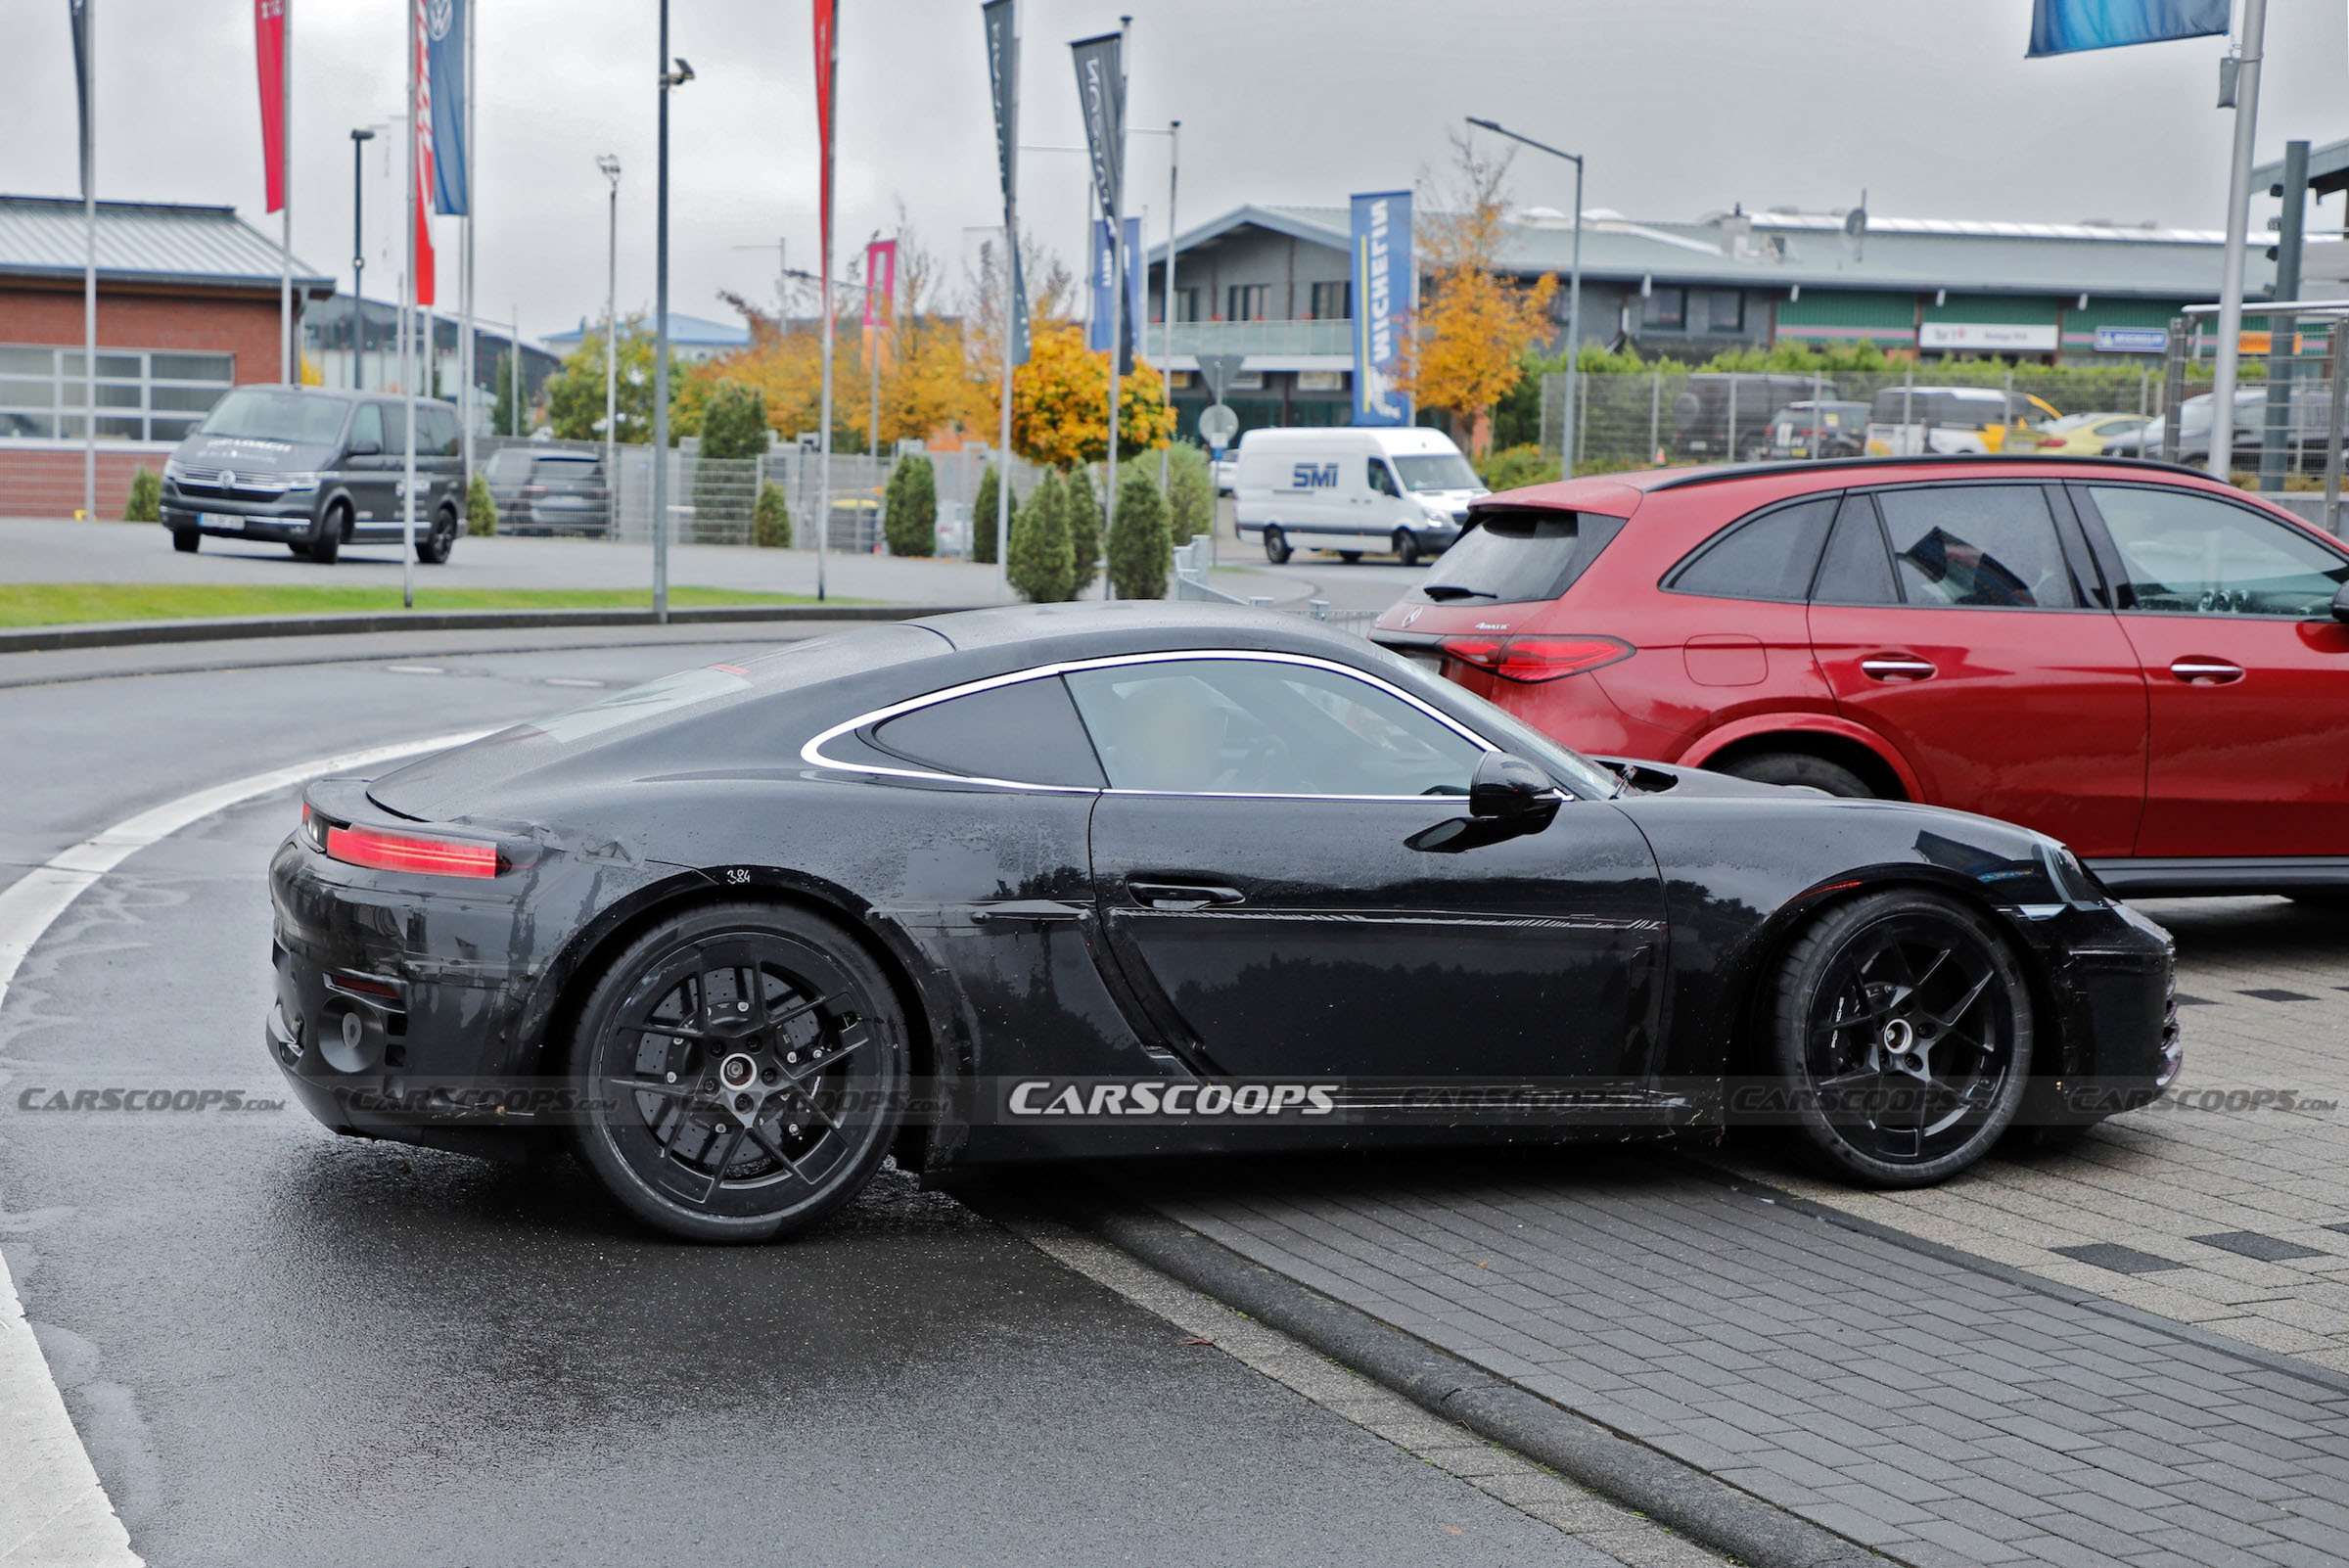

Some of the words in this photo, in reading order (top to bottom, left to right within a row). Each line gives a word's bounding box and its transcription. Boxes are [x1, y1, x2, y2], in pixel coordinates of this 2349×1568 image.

[1293, 462, 1339, 487] SMI
[1475, 622, 1509, 630] 4MATIC
[726, 868, 751, 885] 384
